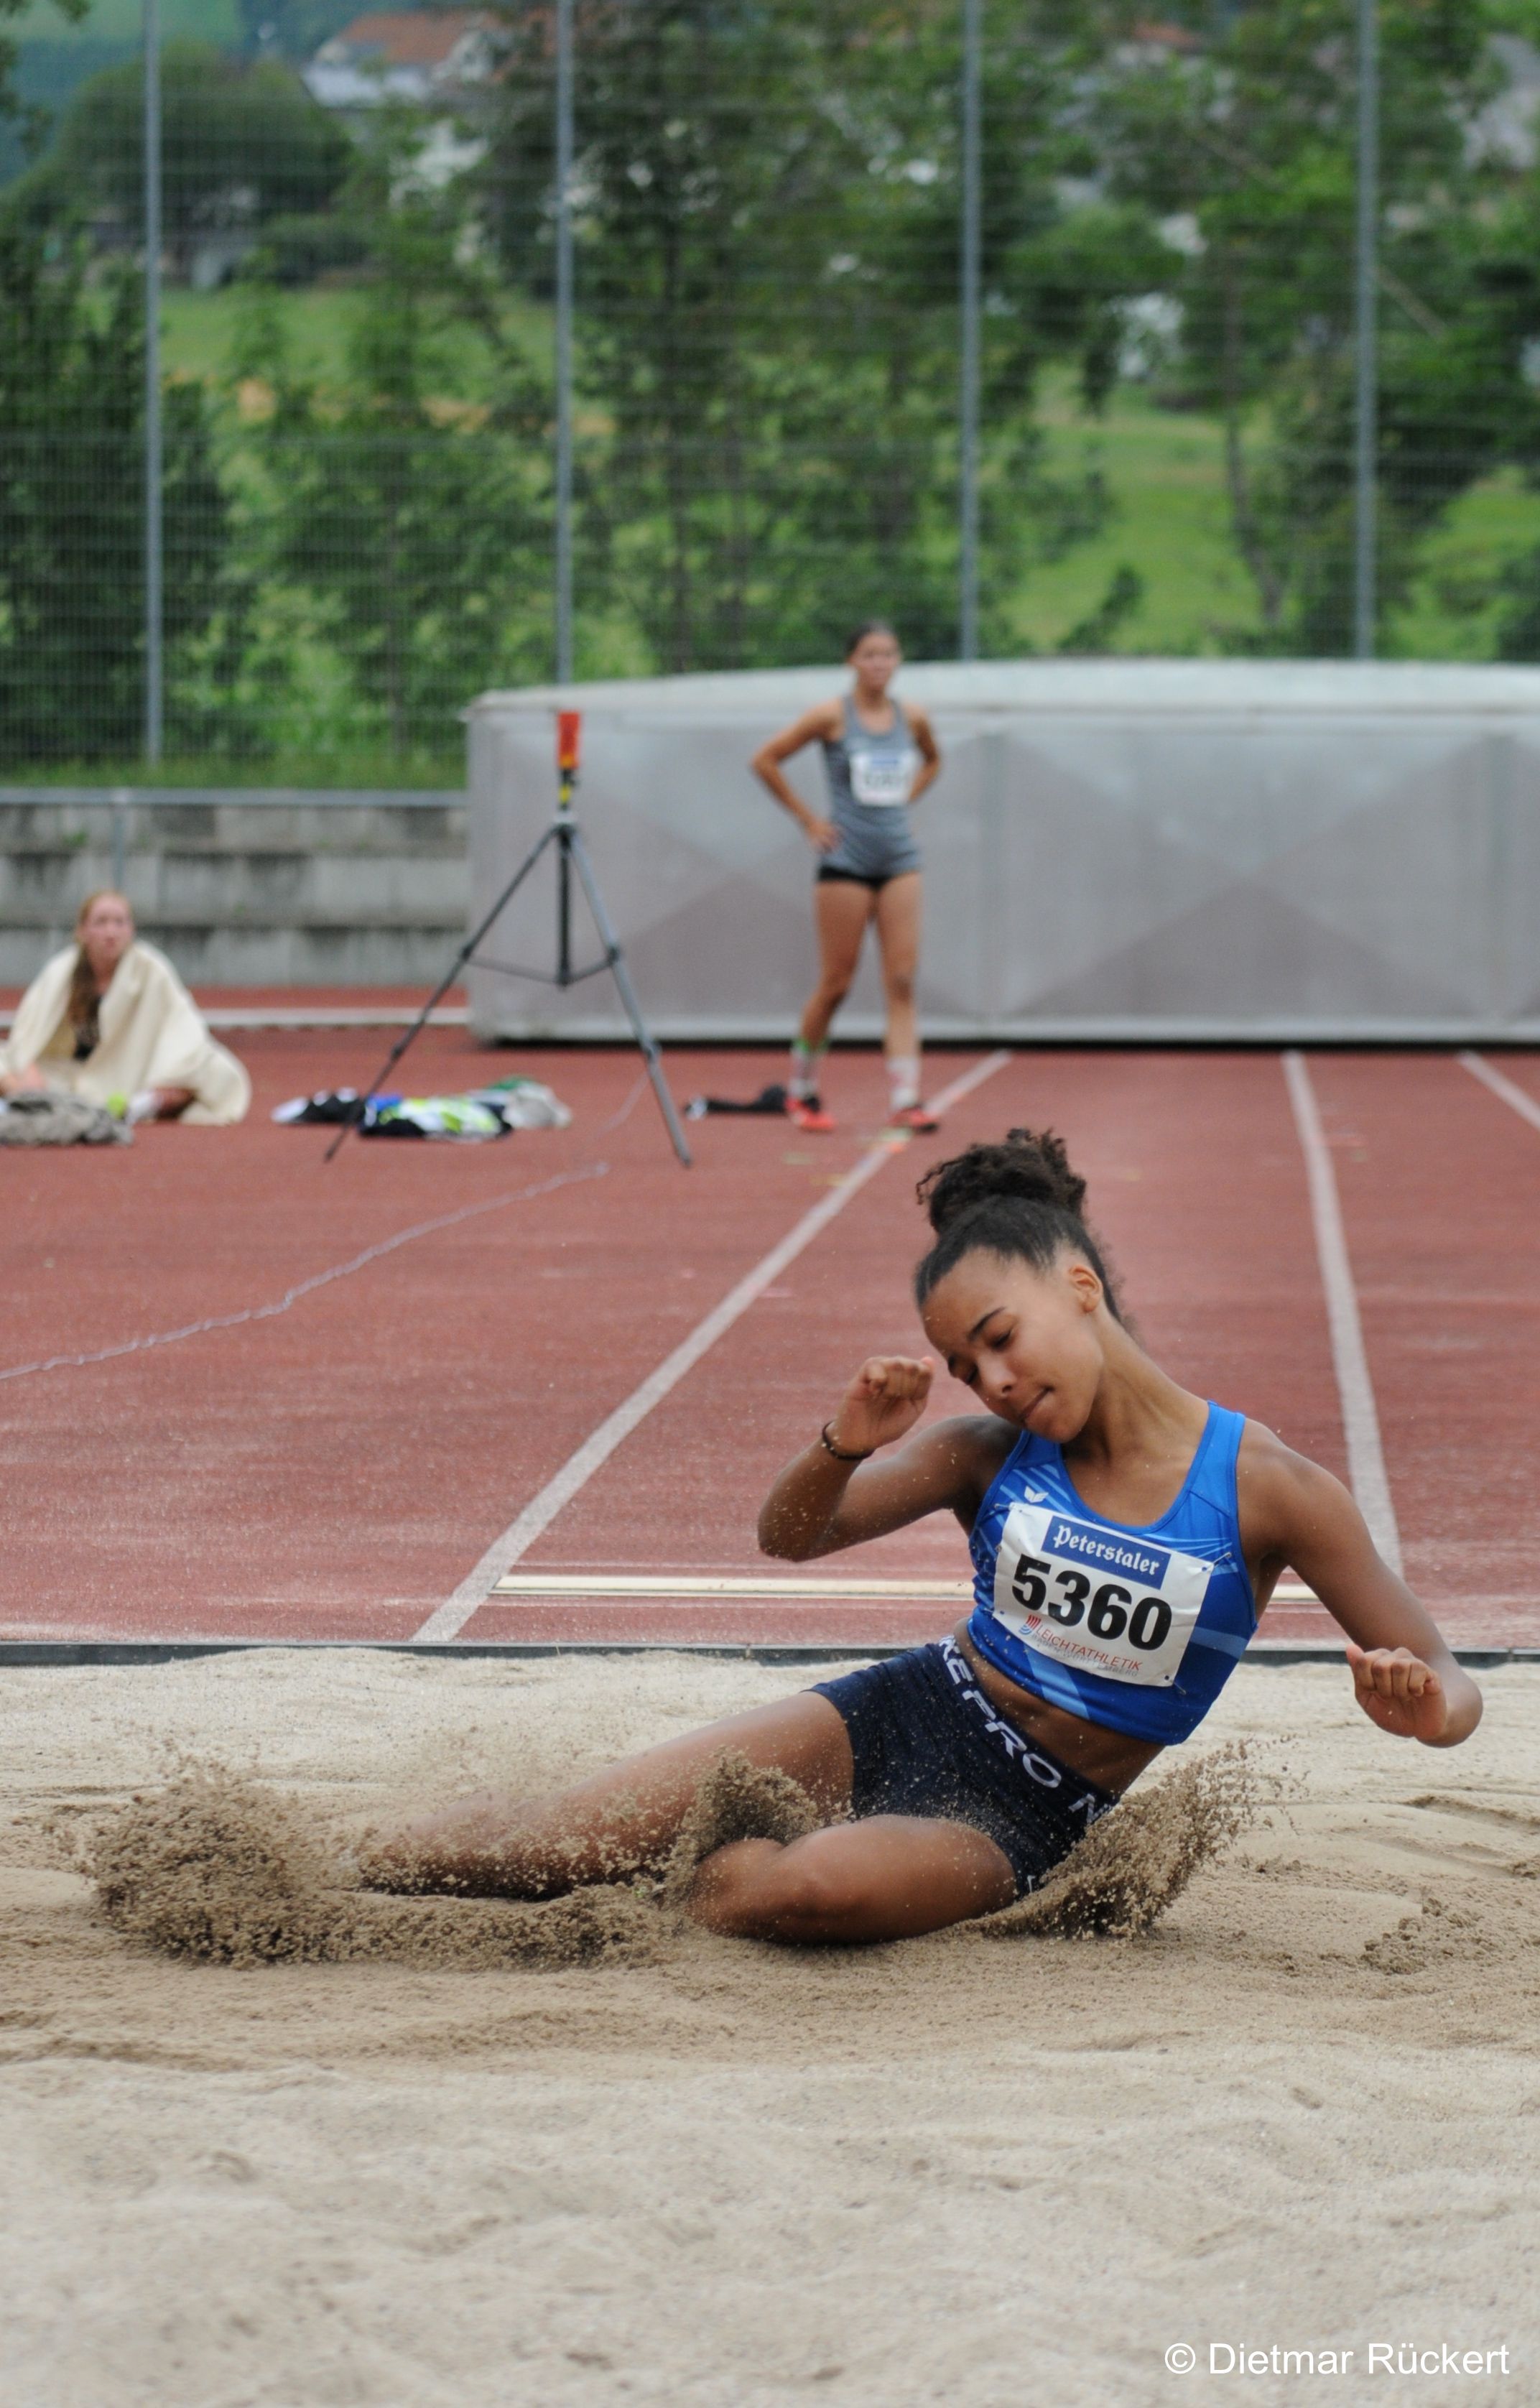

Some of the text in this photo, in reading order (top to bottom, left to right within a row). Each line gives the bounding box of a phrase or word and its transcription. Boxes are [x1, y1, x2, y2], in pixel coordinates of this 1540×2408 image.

[1053, 1524, 1160, 1575] Peterstaler
[1011, 1553, 1172, 1651] 5360
[1036, 1625, 1143, 1672] LEICHTATHLETIK
[962, 1690, 1062, 1788] PRO
